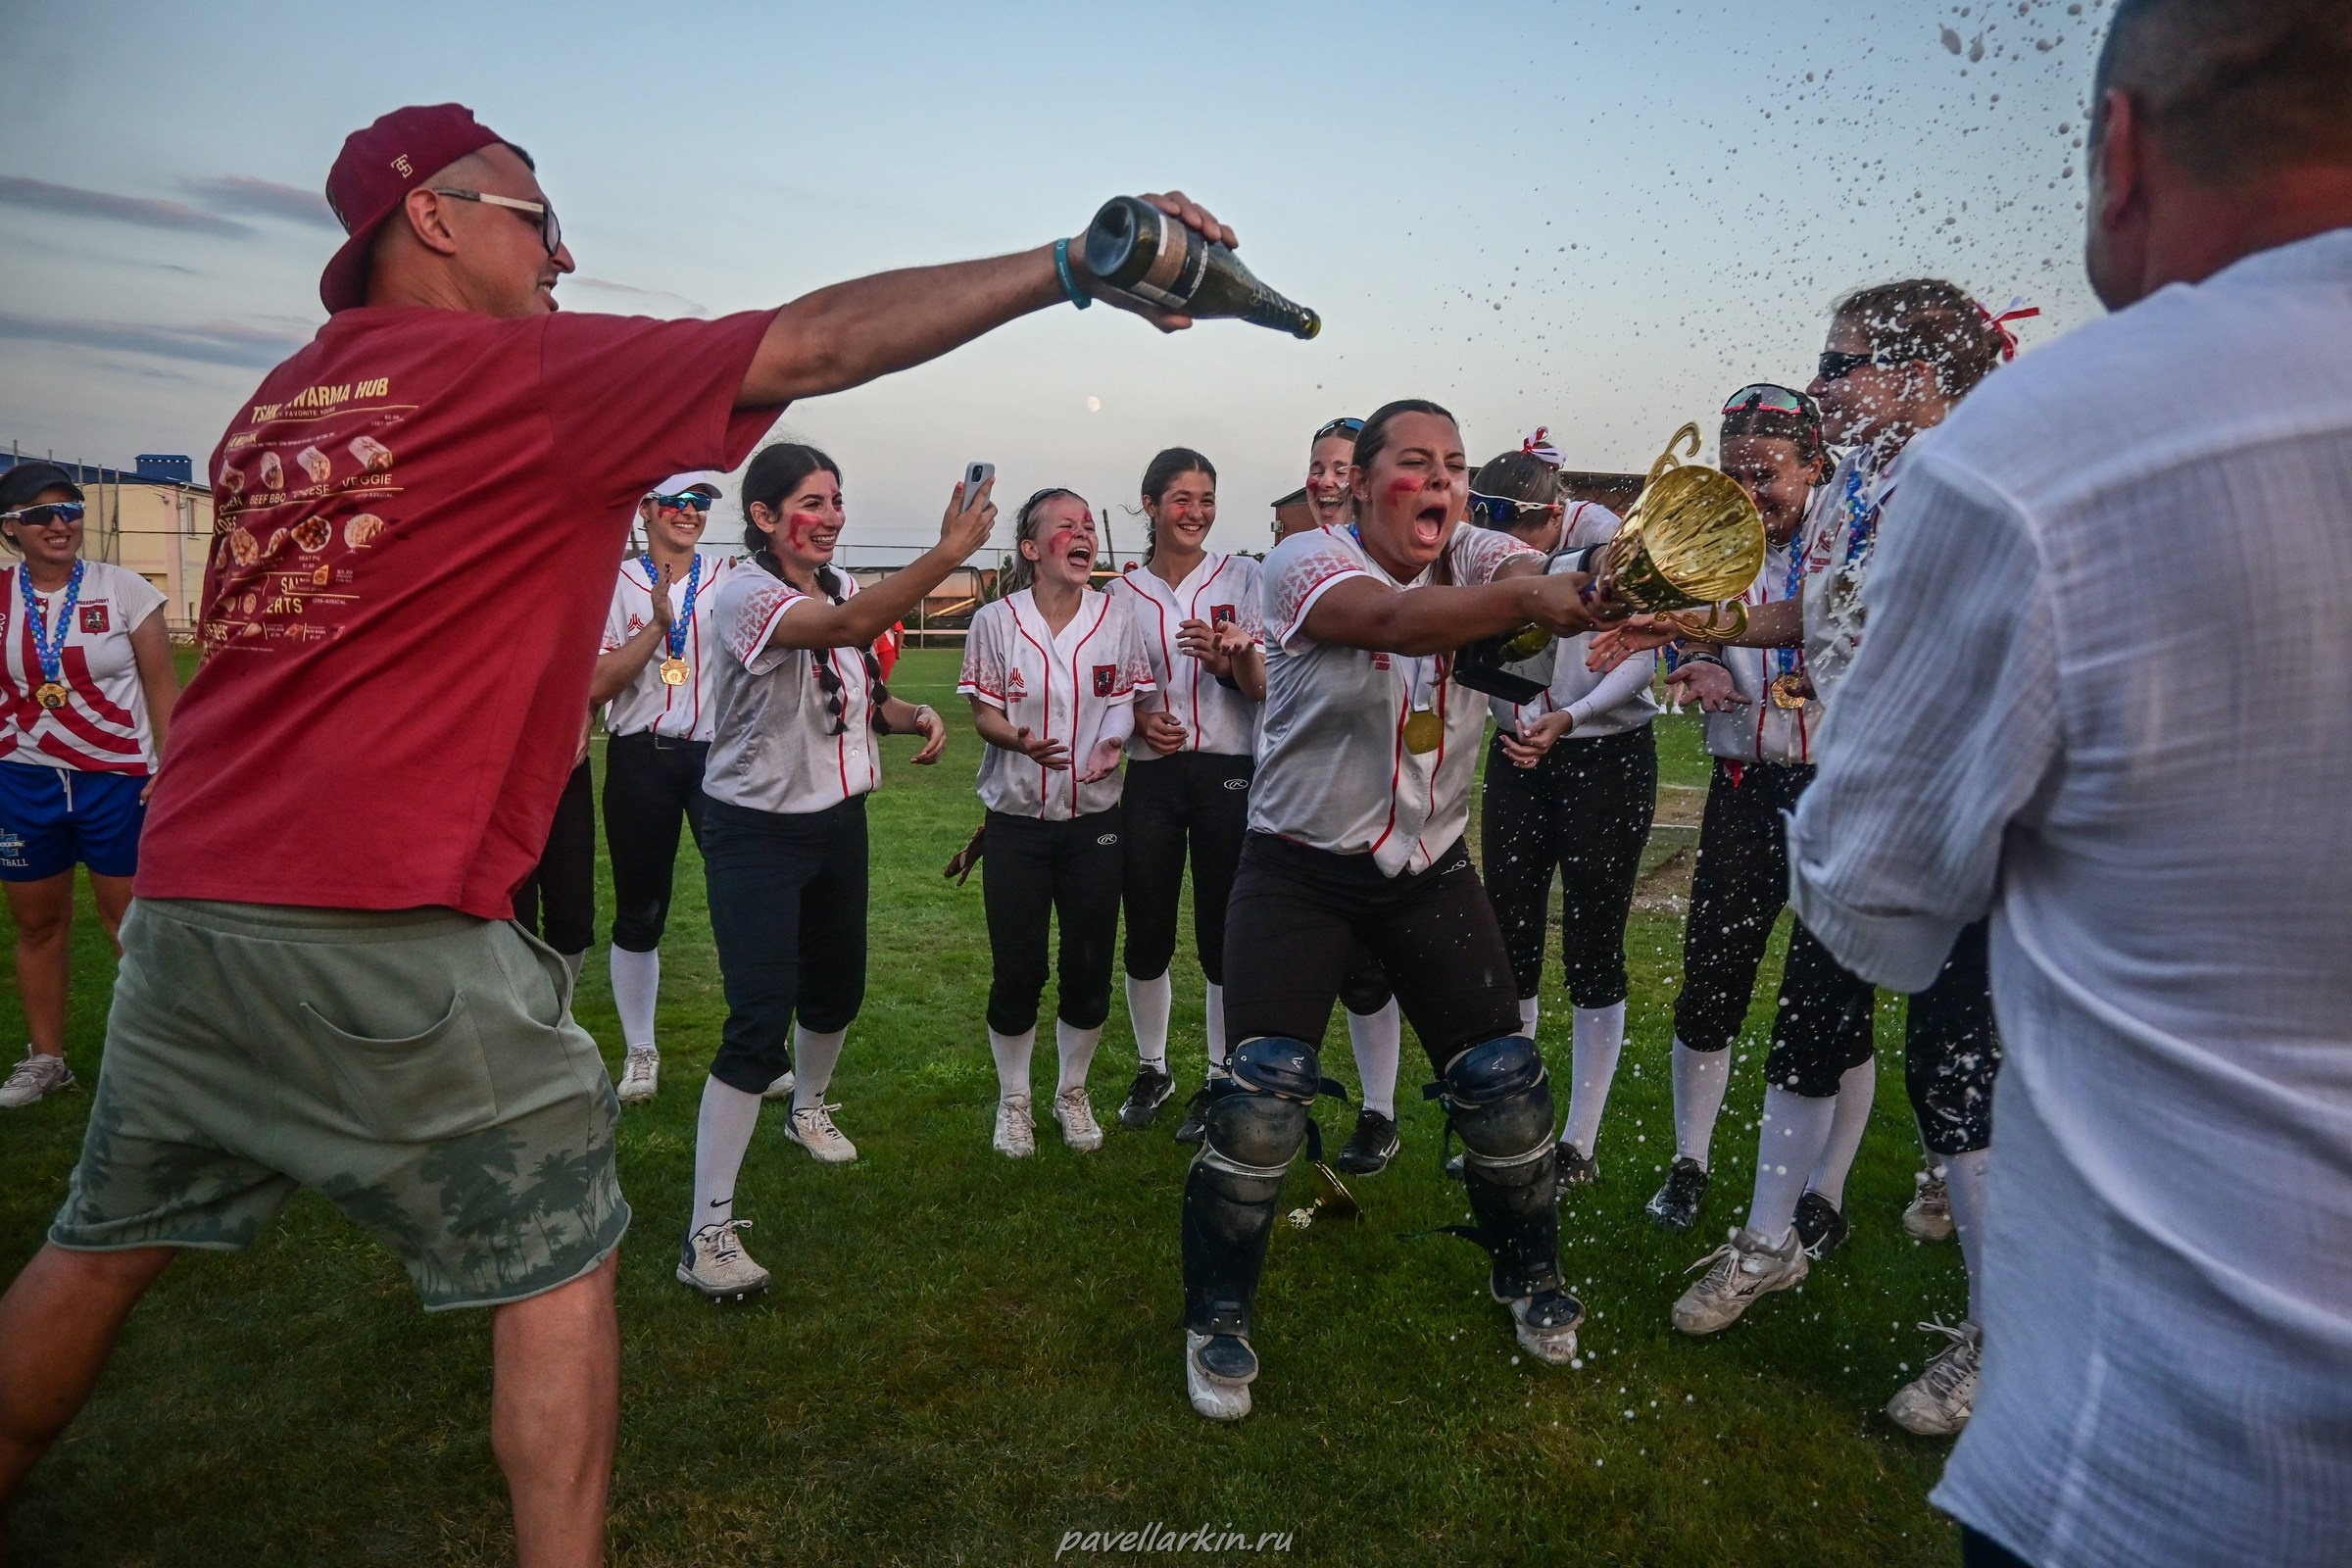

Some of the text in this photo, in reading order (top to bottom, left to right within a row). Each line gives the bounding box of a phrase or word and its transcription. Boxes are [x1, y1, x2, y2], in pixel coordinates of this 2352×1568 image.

[355, 377, 389, 400] HUB
[250, 494, 270, 506] BEEF
[270, 492, 286, 504] BBQ
[342, 473, 393, 488] VEGGIE
